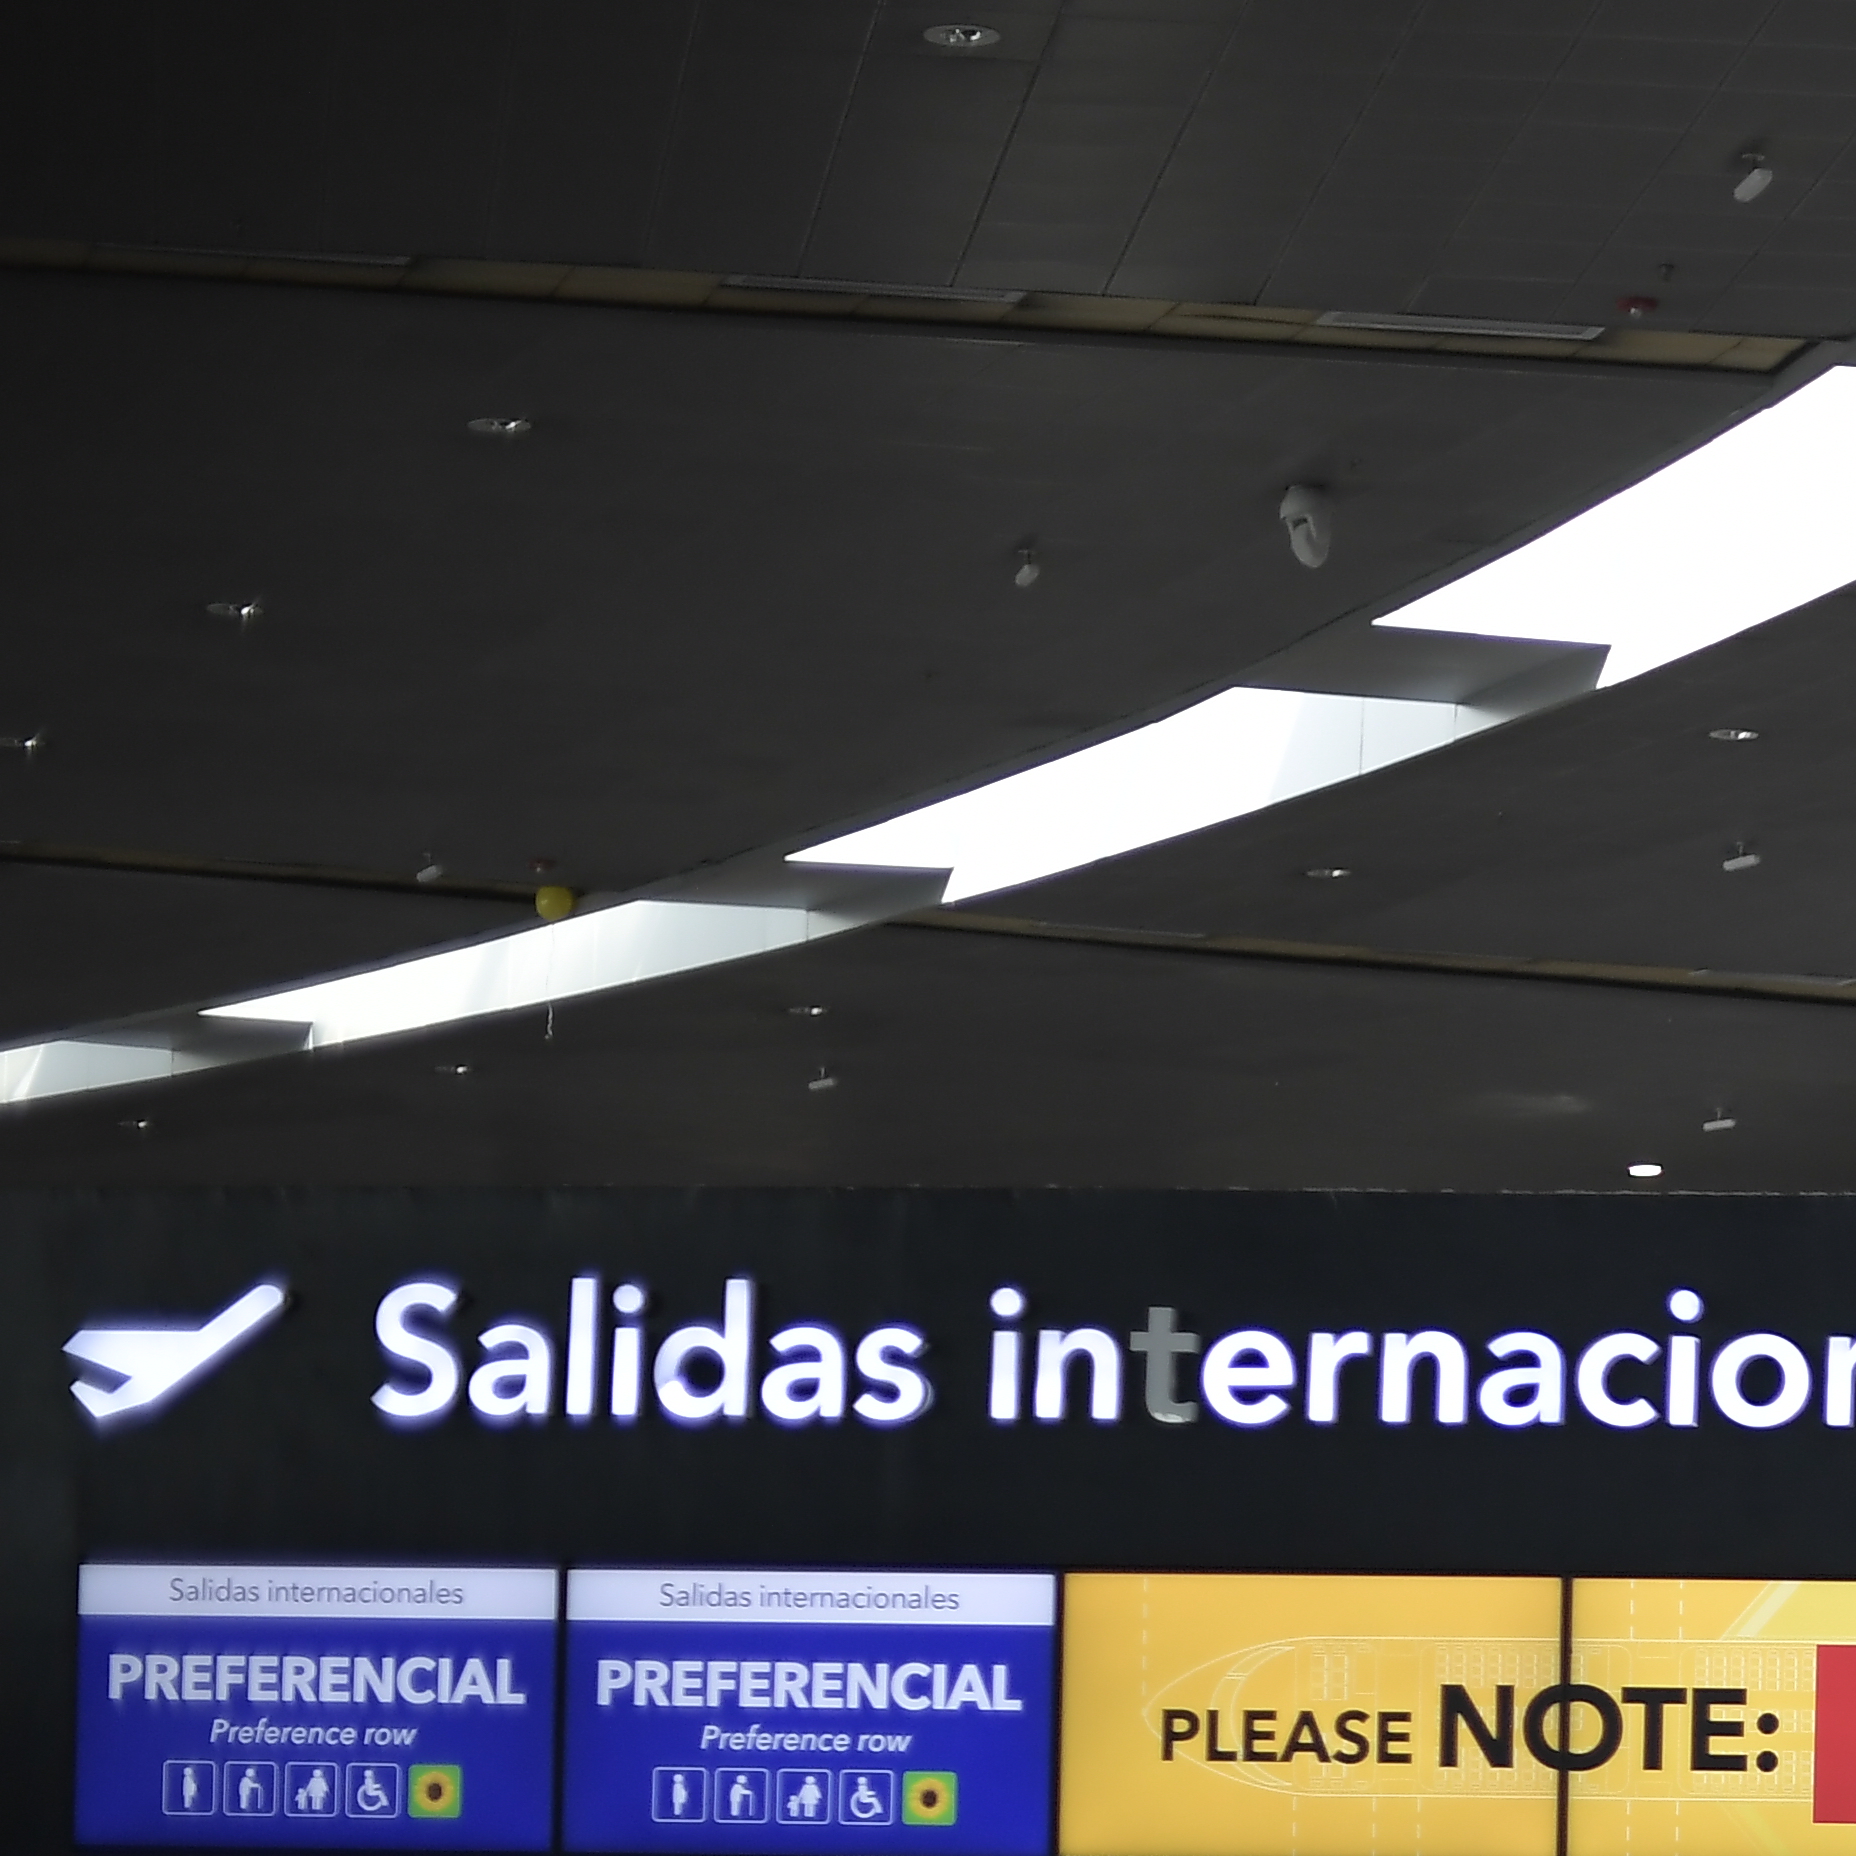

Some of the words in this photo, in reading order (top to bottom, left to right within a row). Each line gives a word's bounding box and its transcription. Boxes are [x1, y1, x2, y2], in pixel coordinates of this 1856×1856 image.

[371, 1276, 930, 1421] Salidas
[169, 1576, 260, 1605] Salidas
[266, 1578, 464, 1607] internacionales
[660, 1582, 750, 1610] Salidas
[756, 1584, 959, 1614] internacionales
[107, 1653, 526, 1705] PREFERENCIAL
[596, 1659, 1022, 1712] PREFERENCIAL
[210, 1717, 358, 1748] Preference
[364, 1724, 417, 1748] row
[700, 1725, 847, 1755] Preference
[855, 1730, 911, 1755] row
[1161, 1708, 1412, 1765] PLEASE
[1440, 1684, 1781, 1773] NOTE:
